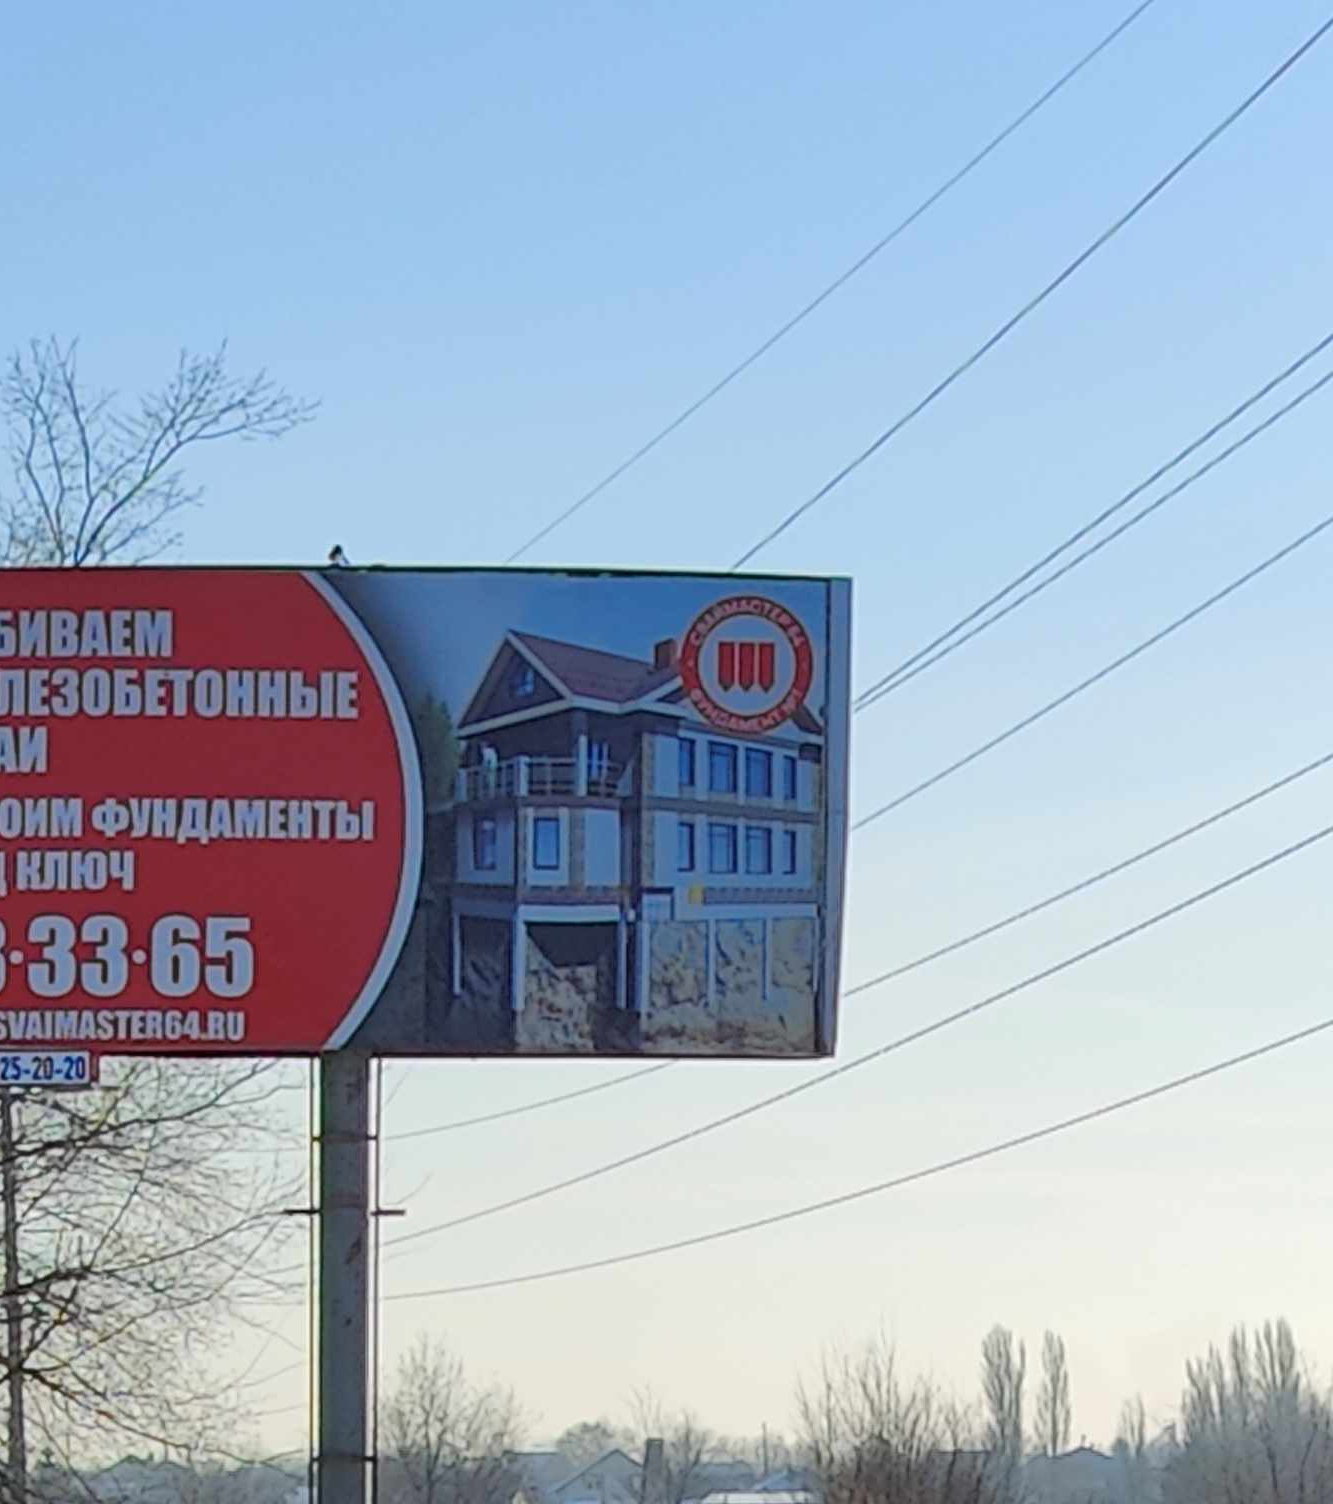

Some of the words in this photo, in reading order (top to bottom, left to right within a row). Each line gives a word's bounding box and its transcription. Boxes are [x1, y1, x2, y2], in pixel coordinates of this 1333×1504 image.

[90, 798, 375, 844] ФУНДАМЕНТЫ
[16, 851, 135, 892] КЛЮЧ
[0, 1056, 85, 1081] 25-20-20
